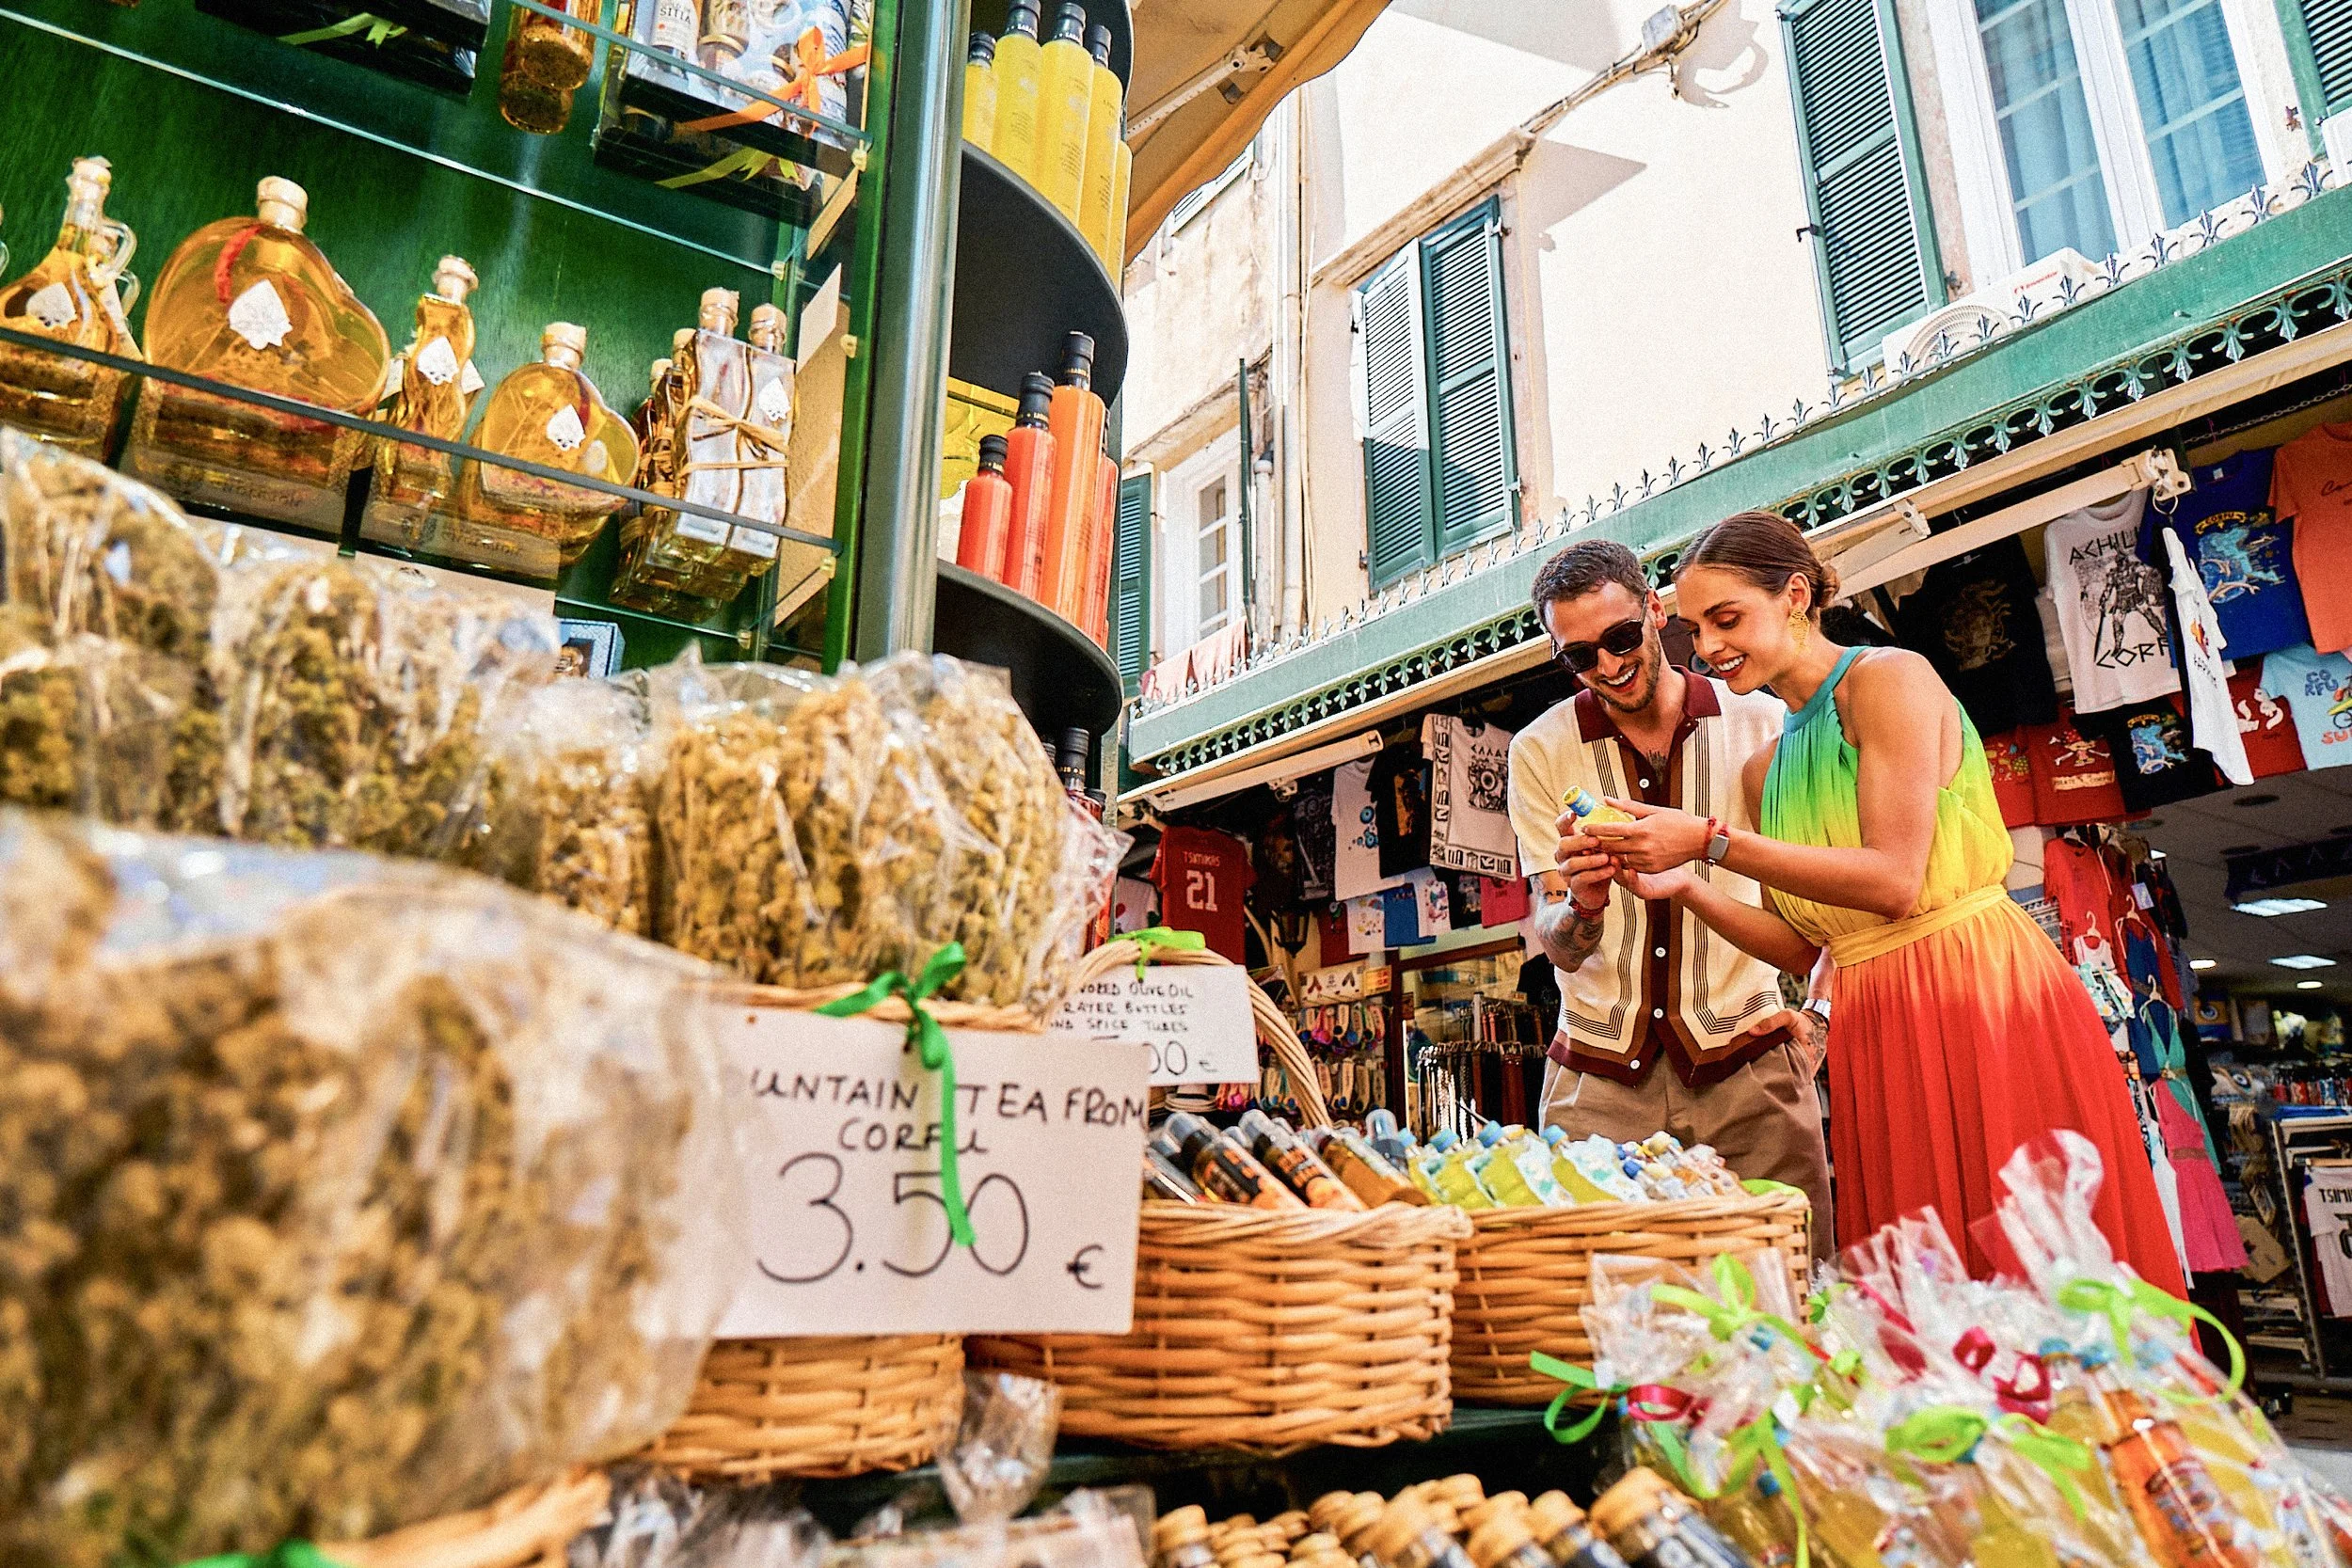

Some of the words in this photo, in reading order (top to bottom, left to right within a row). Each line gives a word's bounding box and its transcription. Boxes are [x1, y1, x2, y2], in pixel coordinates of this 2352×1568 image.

[1186, 869, 1217, 912] 21
[1088, 1019, 1128, 1031] SPICE
[955, 1083, 1049, 1122] TEA
[1064, 1086, 1148, 1127] FROM
[838, 1117, 989, 1155] CORFU
[756, 1152, 1029, 1284] 3.50
[1067, 1244, 1104, 1290] €
